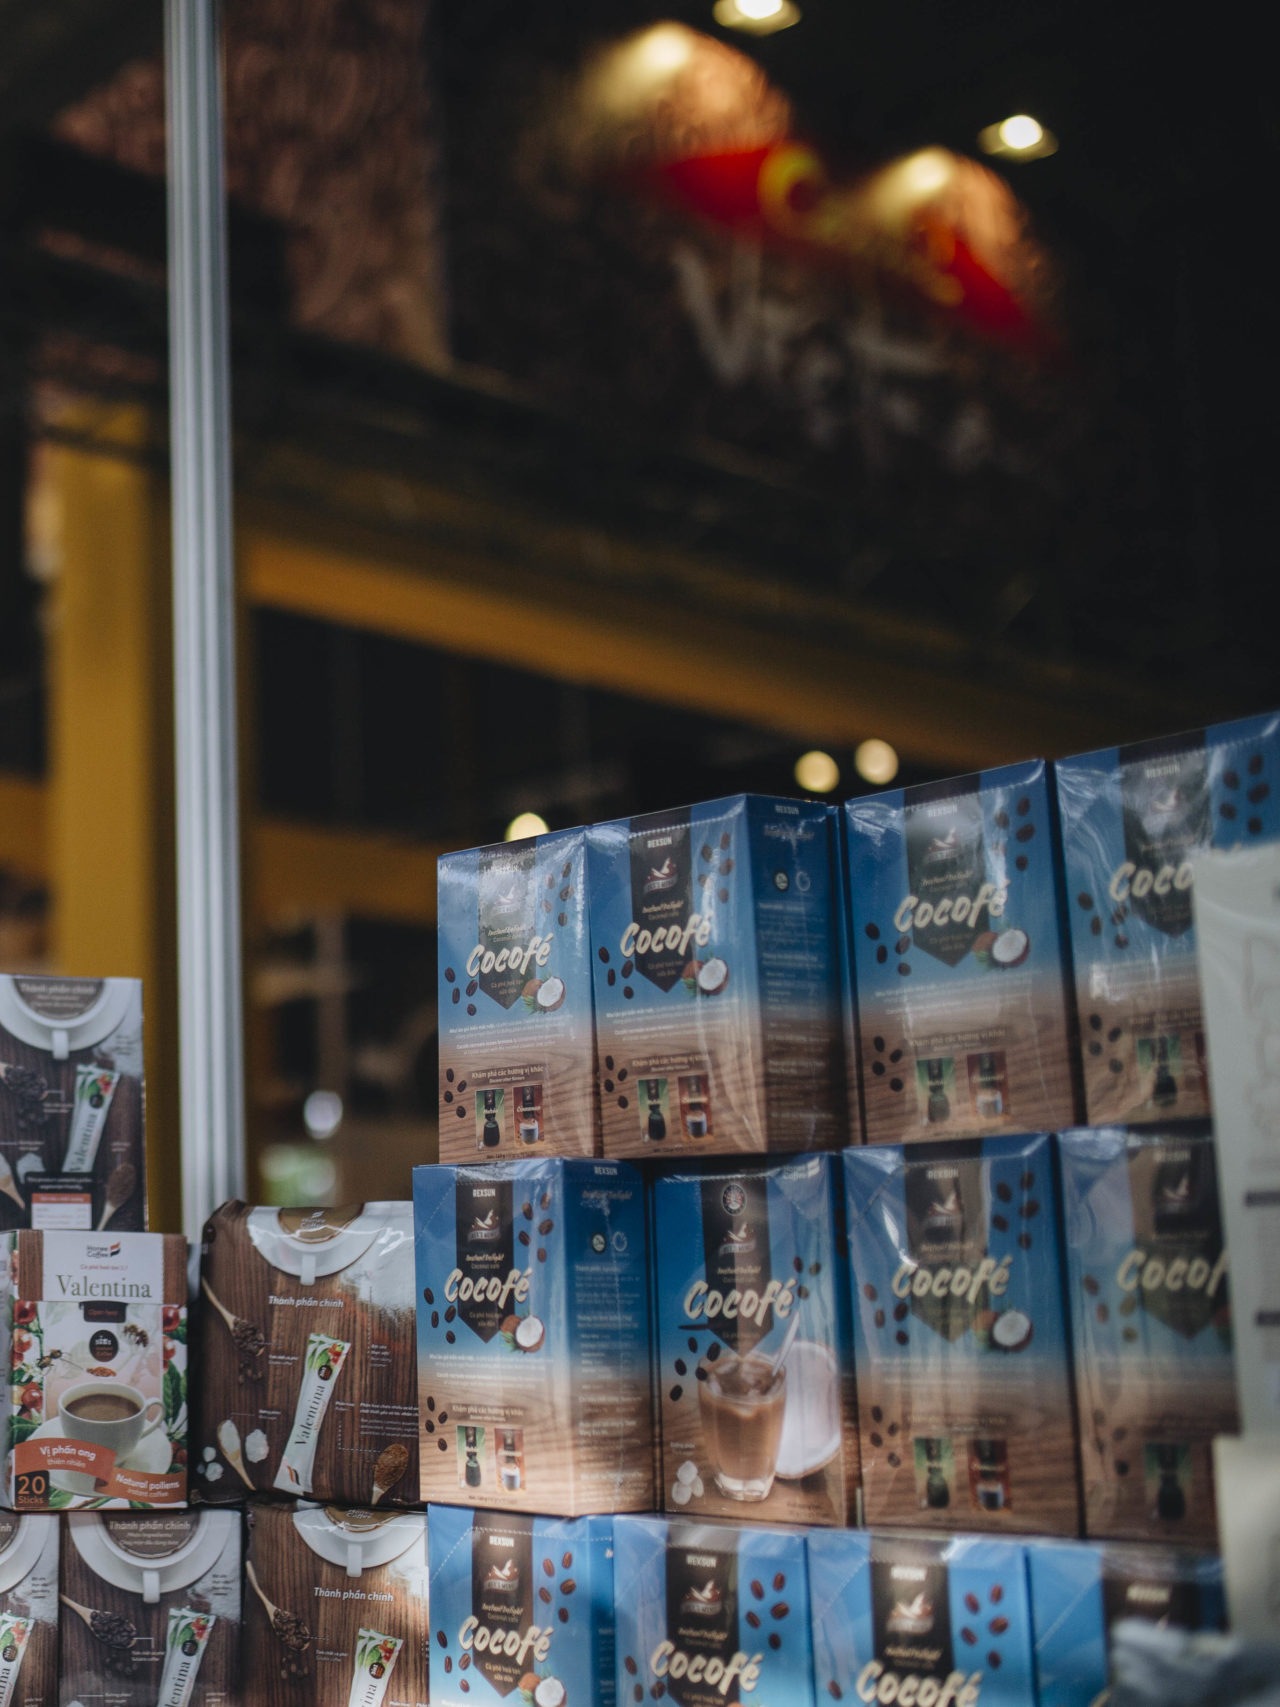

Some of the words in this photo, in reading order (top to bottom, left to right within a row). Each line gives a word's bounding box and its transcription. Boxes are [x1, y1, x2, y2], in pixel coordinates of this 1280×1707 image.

[647, 837, 672, 848] REXSUN
[1110, 862, 1193, 903] Coco
[893, 878, 1011, 934] Cocofé
[466, 932, 554, 977] Cocofé
[620, 911, 713, 958] Cocofé
[473, 1188, 496, 1198] REXSUN
[56, 1274, 152, 1298] Valentina
[444, 1267, 533, 1309] Cocofé
[891, 1255, 1014, 1303] Cocofé
[1118, 1249, 1230, 1297] Cocof
[268, 1295, 295, 1306] Thành
[319, 1299, 344, 1308] chính
[683, 1278, 798, 1326] Cocofé
[294, 1385, 326, 1446] Valentina
[17, 1476, 46, 1495] 20
[17, 1496, 44, 1504] Sticks
[116, 1473, 148, 1488] Natural
[489, 1535, 515, 1548] REXSUN
[314, 1587, 341, 1598] Thành
[368, 1591, 394, 1601] chính
[457, 1614, 555, 1667] Cocofé
[649, 1639, 766, 1696] Cocofé
[855, 1659, 984, 1707] Cocofé
